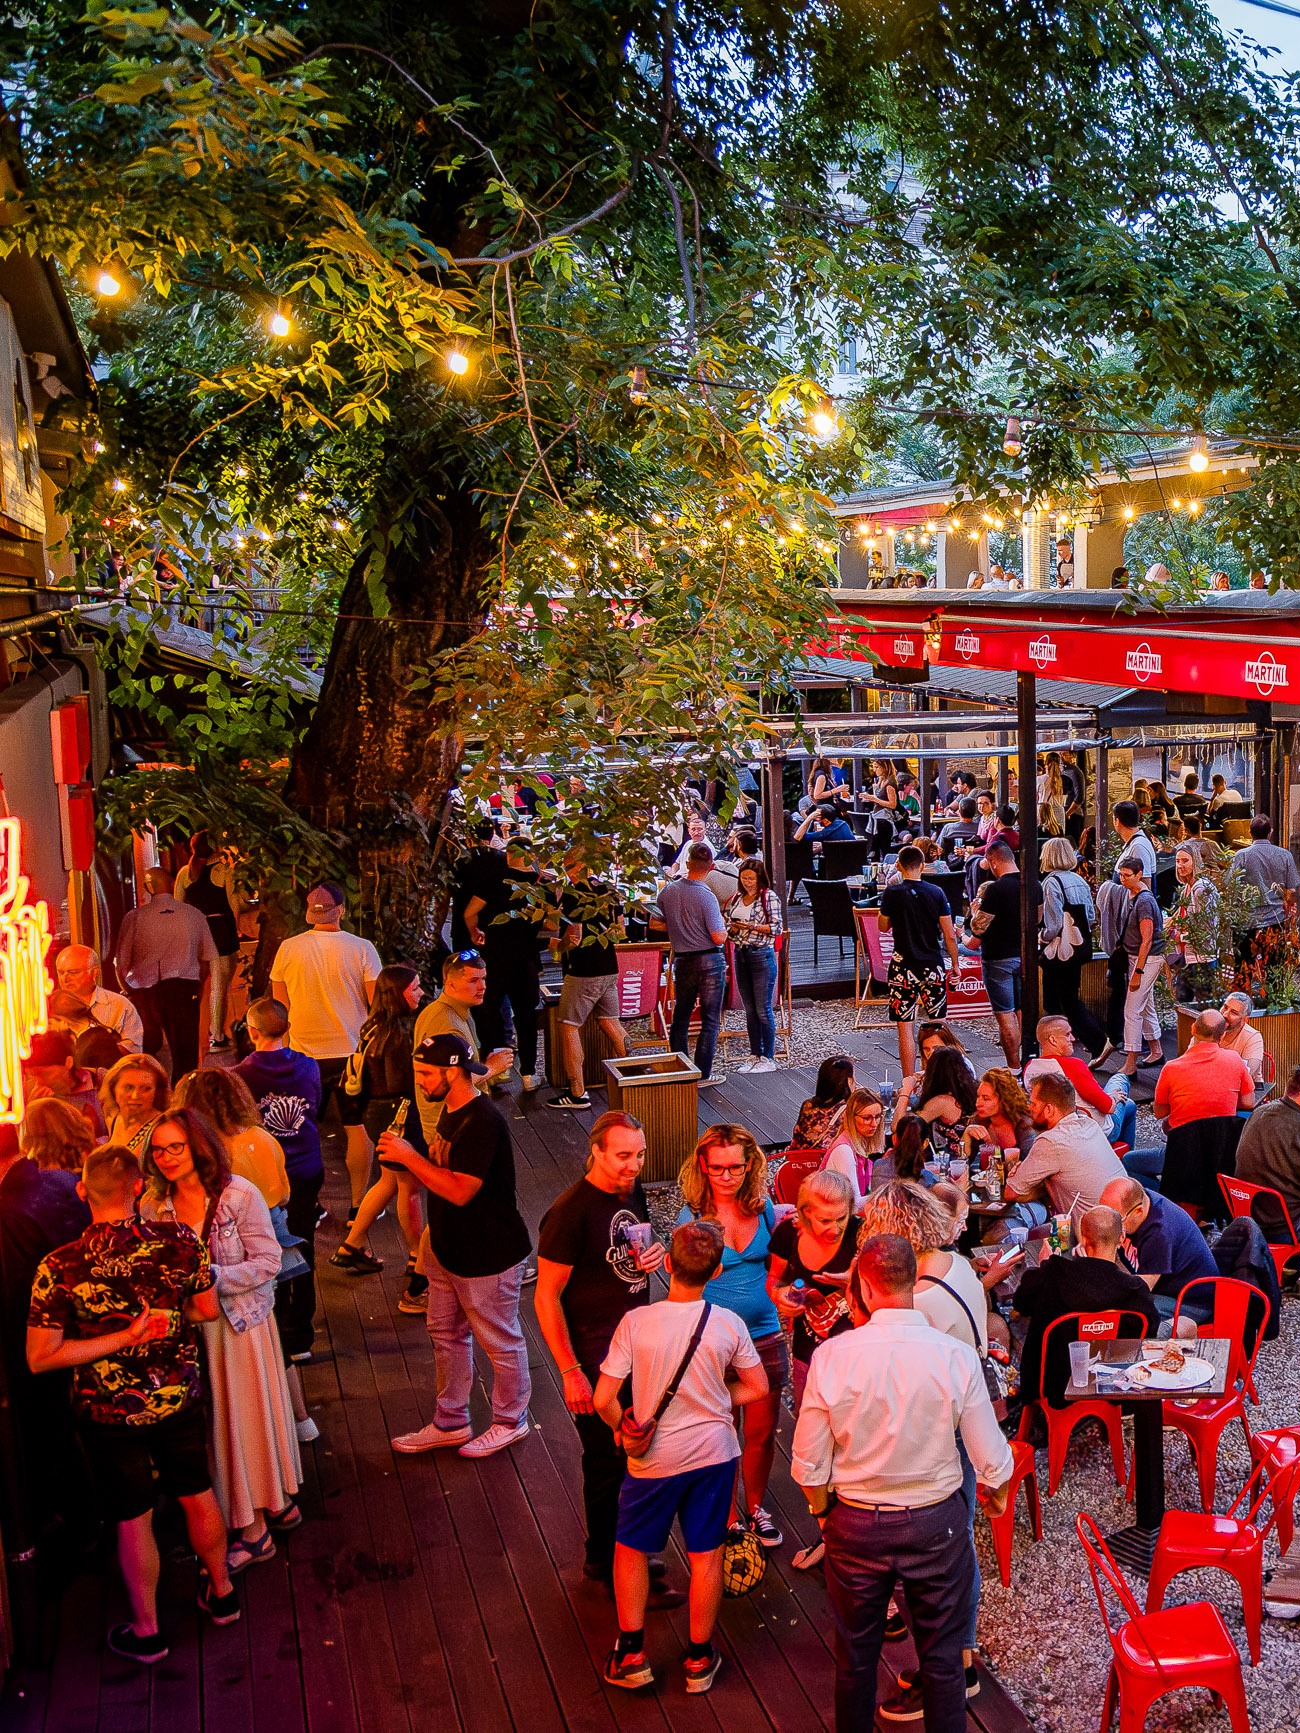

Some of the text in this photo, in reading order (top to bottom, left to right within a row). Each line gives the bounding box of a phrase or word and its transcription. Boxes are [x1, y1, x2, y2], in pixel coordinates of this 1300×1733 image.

[956, 637, 979, 652] MARTINI
[1030, 643, 1056, 660] MARTINI
[1127, 652, 1160, 671] MARTINI
[1246, 663, 1286, 684] MARTINI
[1082, 1322, 1114, 1332] MARTINI
